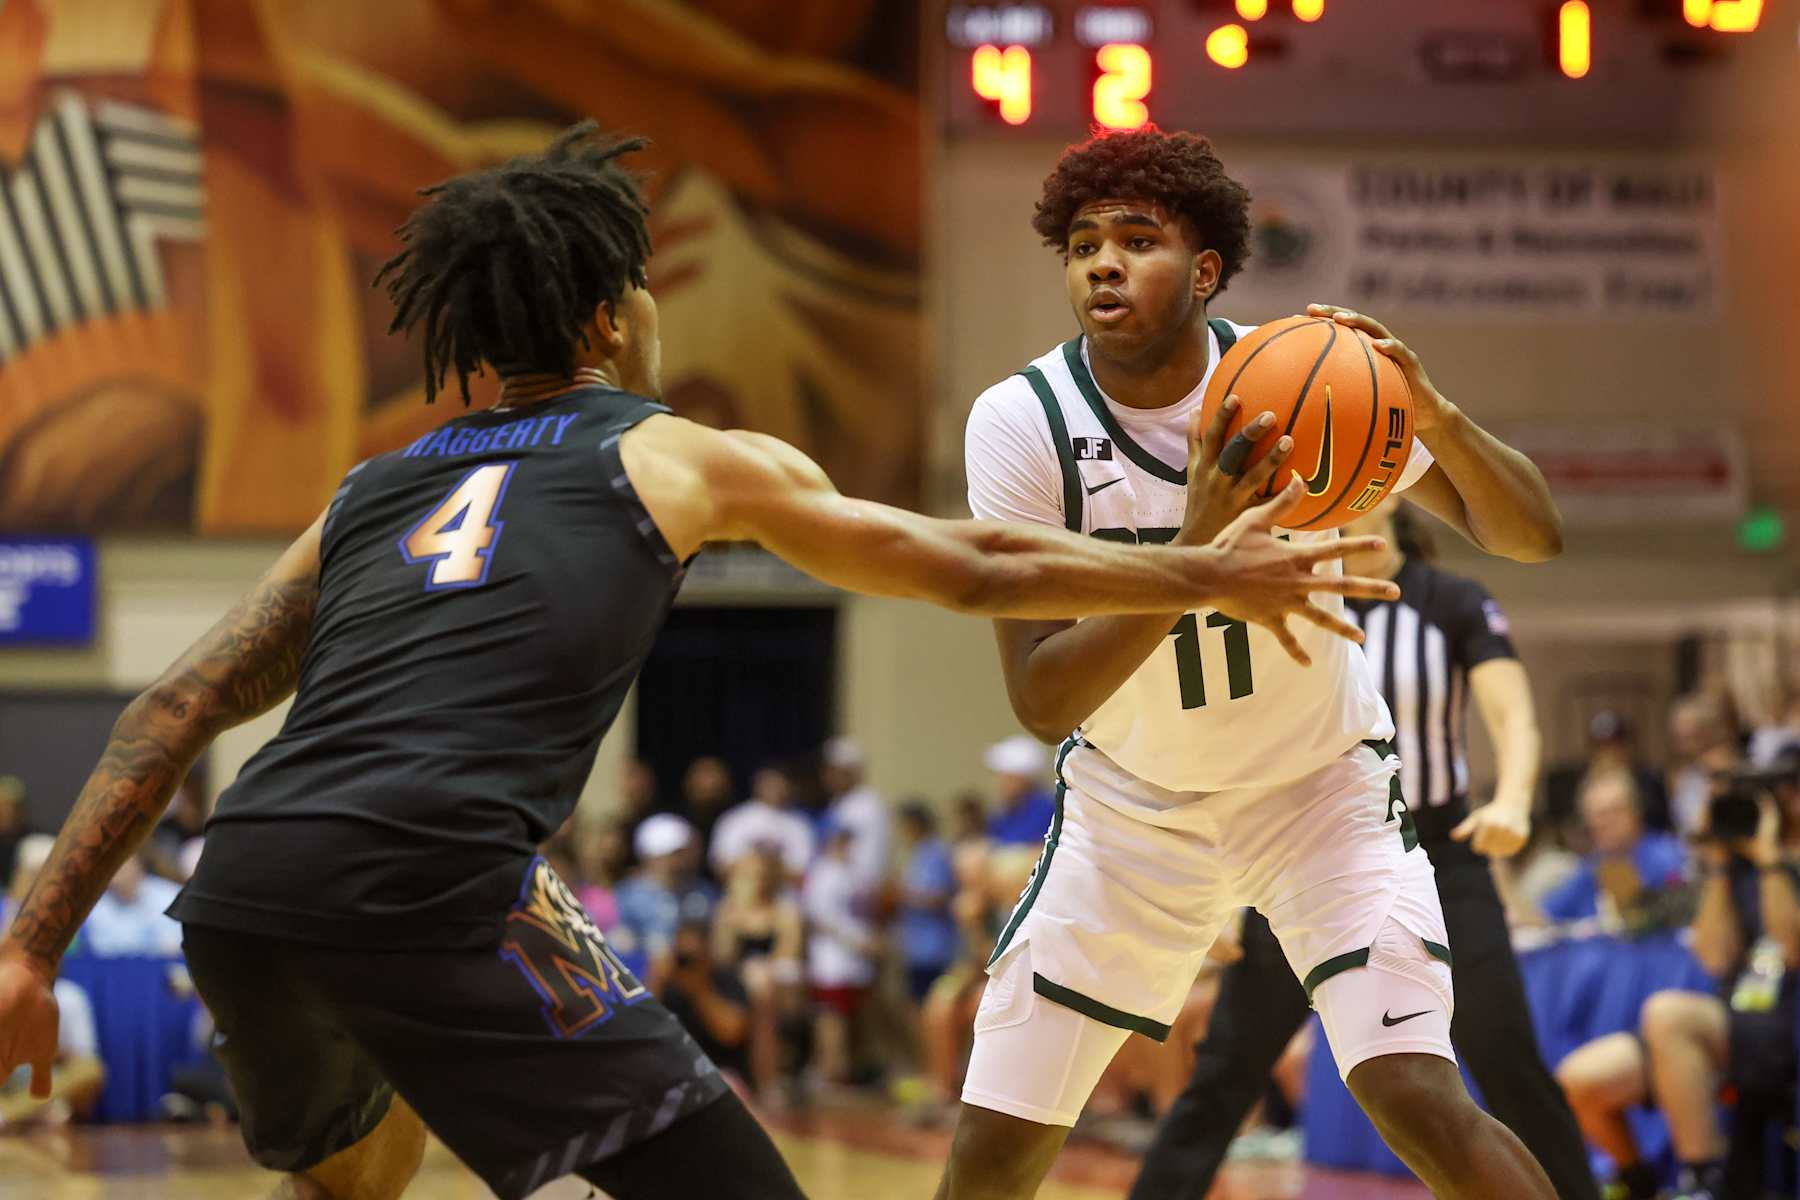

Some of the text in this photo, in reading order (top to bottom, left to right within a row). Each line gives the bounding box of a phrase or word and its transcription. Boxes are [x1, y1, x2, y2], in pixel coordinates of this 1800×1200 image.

[972, 44, 1032, 125] 4
[1093, 43, 1153, 129] 2
[1350, 166, 1527, 208] COUNTY
[1543, 167, 1596, 208] OF
[403, 412, 575, 457] HAGGERTY
[1080, 438, 1104, 459] JF
[1346, 406, 1405, 512] ELITE
[398, 460, 519, 592] 4
[1167, 610, 1254, 710] 11
